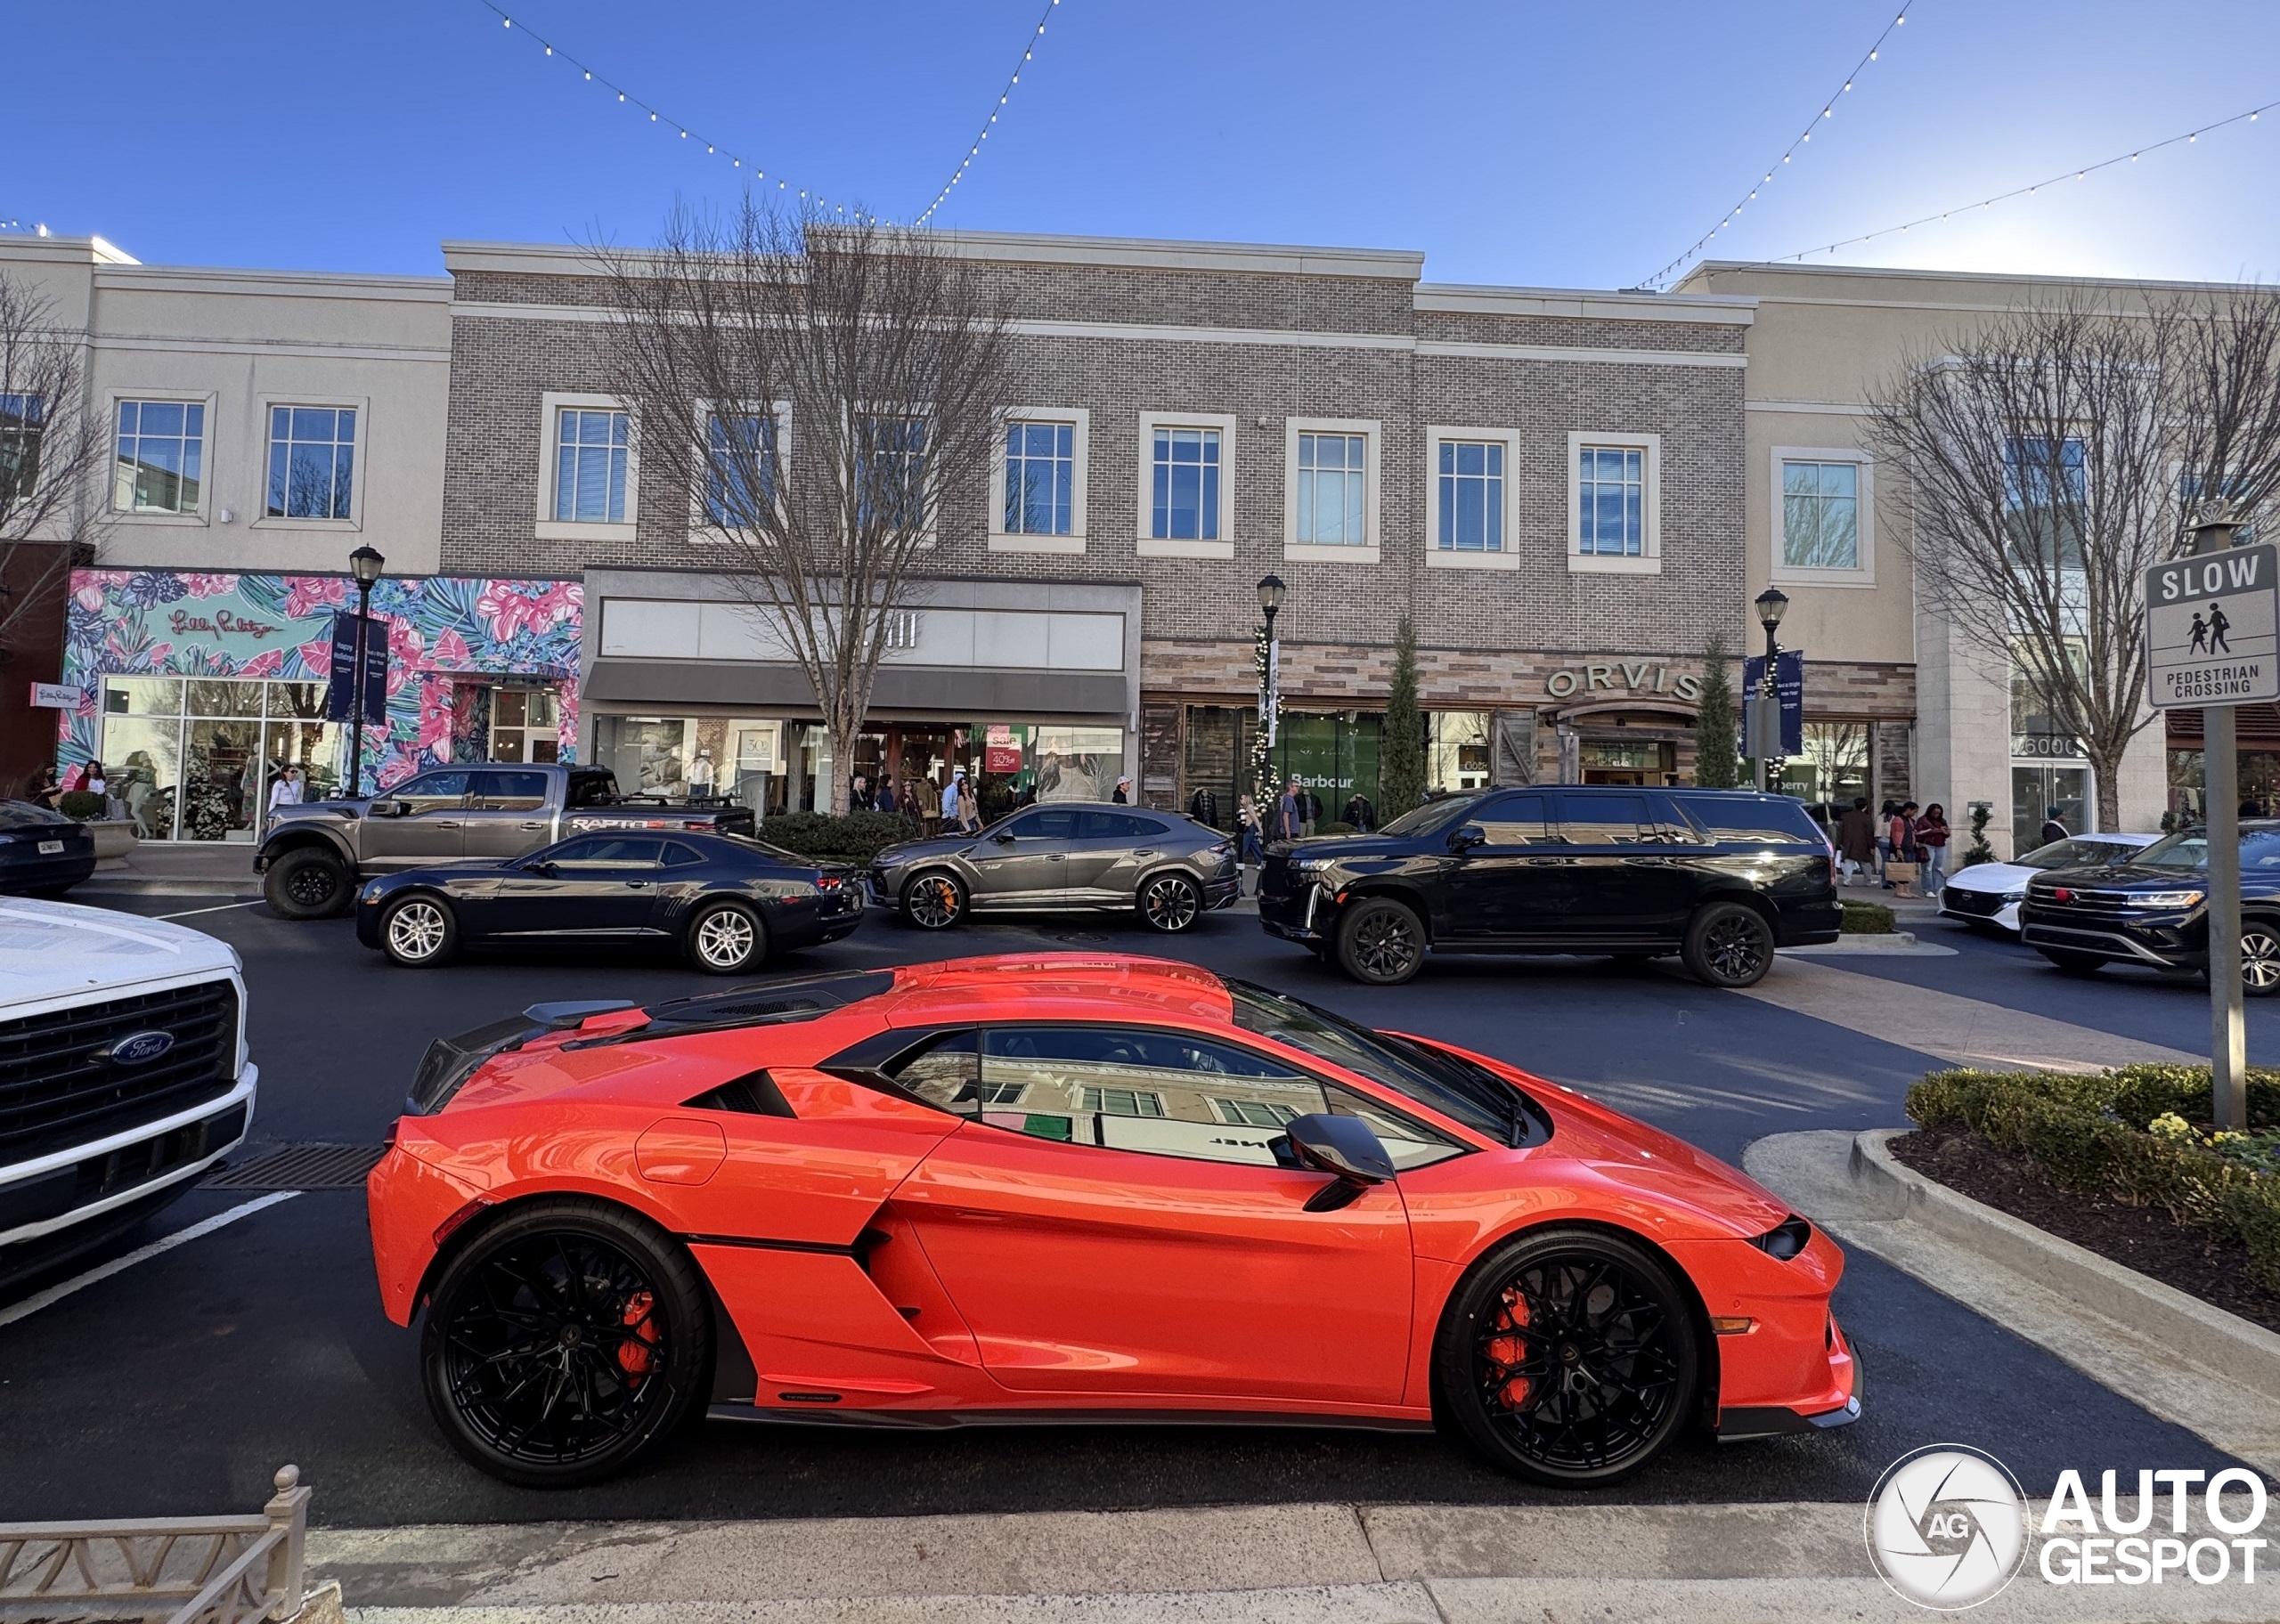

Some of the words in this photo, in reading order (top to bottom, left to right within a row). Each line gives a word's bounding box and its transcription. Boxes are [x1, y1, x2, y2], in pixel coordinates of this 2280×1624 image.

[2162, 554, 2260, 600] SLOW
[168, 609, 220, 641] Lilly
[216, 609, 285, 639] Pulitzer
[1547, 662, 1702, 702] ORVIS
[2167, 664, 2260, 686] PEDESTRIAN
[2175, 679, 2251, 698] CROSSING
[992, 736, 1017, 745] sale
[1291, 773, 1355, 789] Barbour
[129, 1037, 163, 1059] Ford
